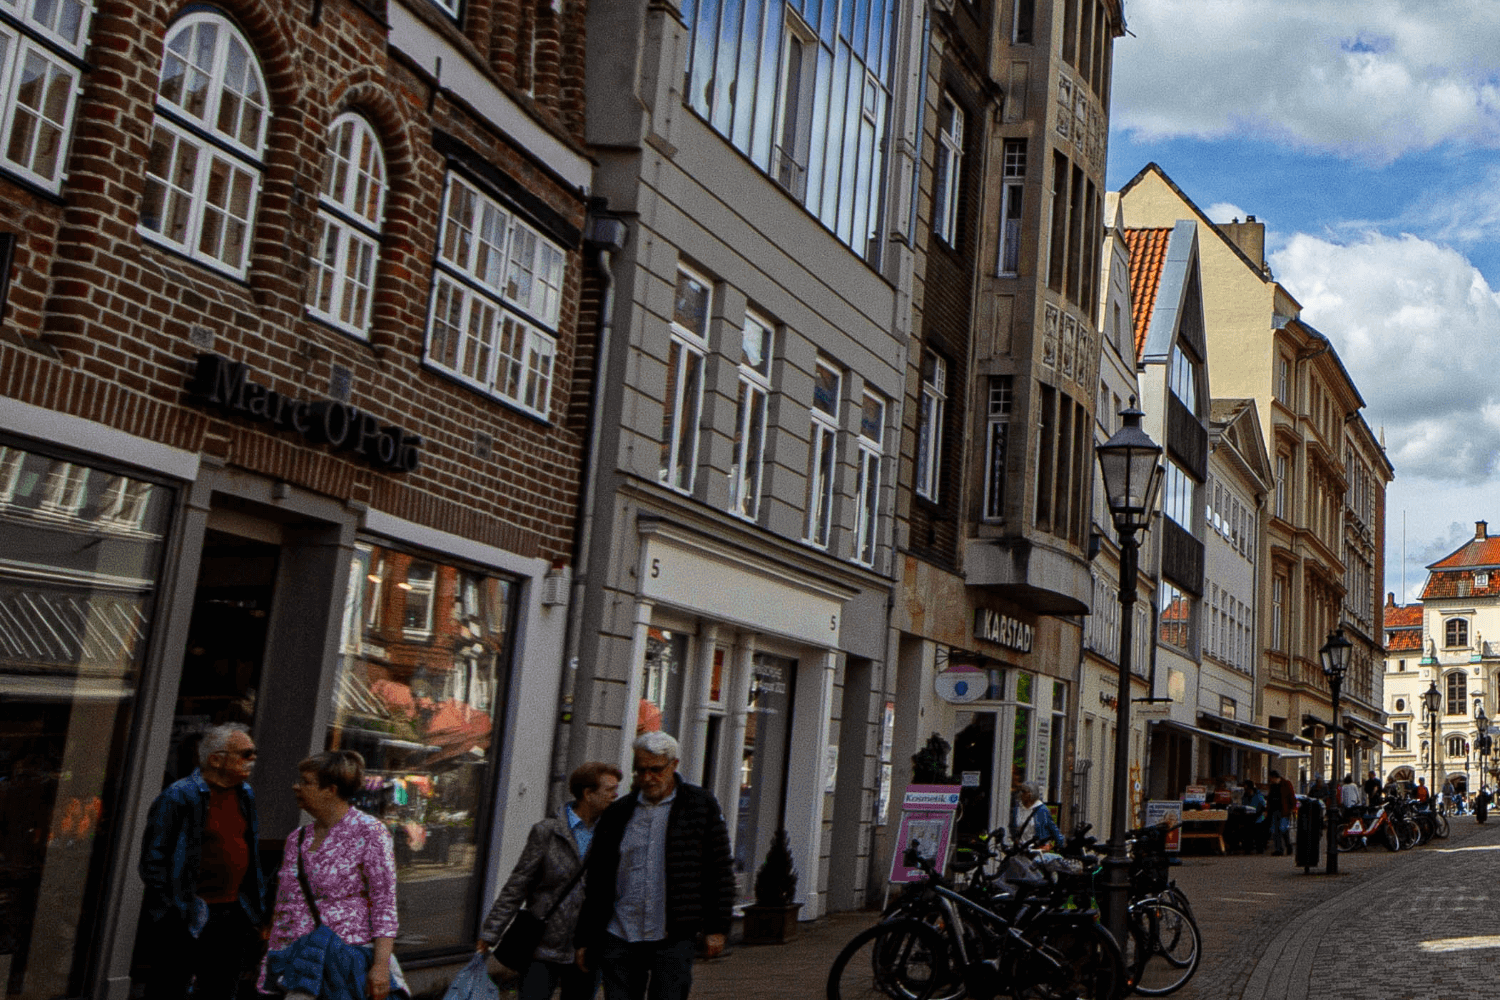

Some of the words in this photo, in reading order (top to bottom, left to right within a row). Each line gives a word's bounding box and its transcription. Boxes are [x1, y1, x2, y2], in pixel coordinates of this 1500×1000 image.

[209, 356, 310, 433] Marc
[325, 401, 419, 472] O'Polo
[651, 558, 660, 578] 5
[830, 615, 836, 631] 5
[983, 608, 1036, 653] KARSTADT
[905, 793, 946, 803] Kosmetik
